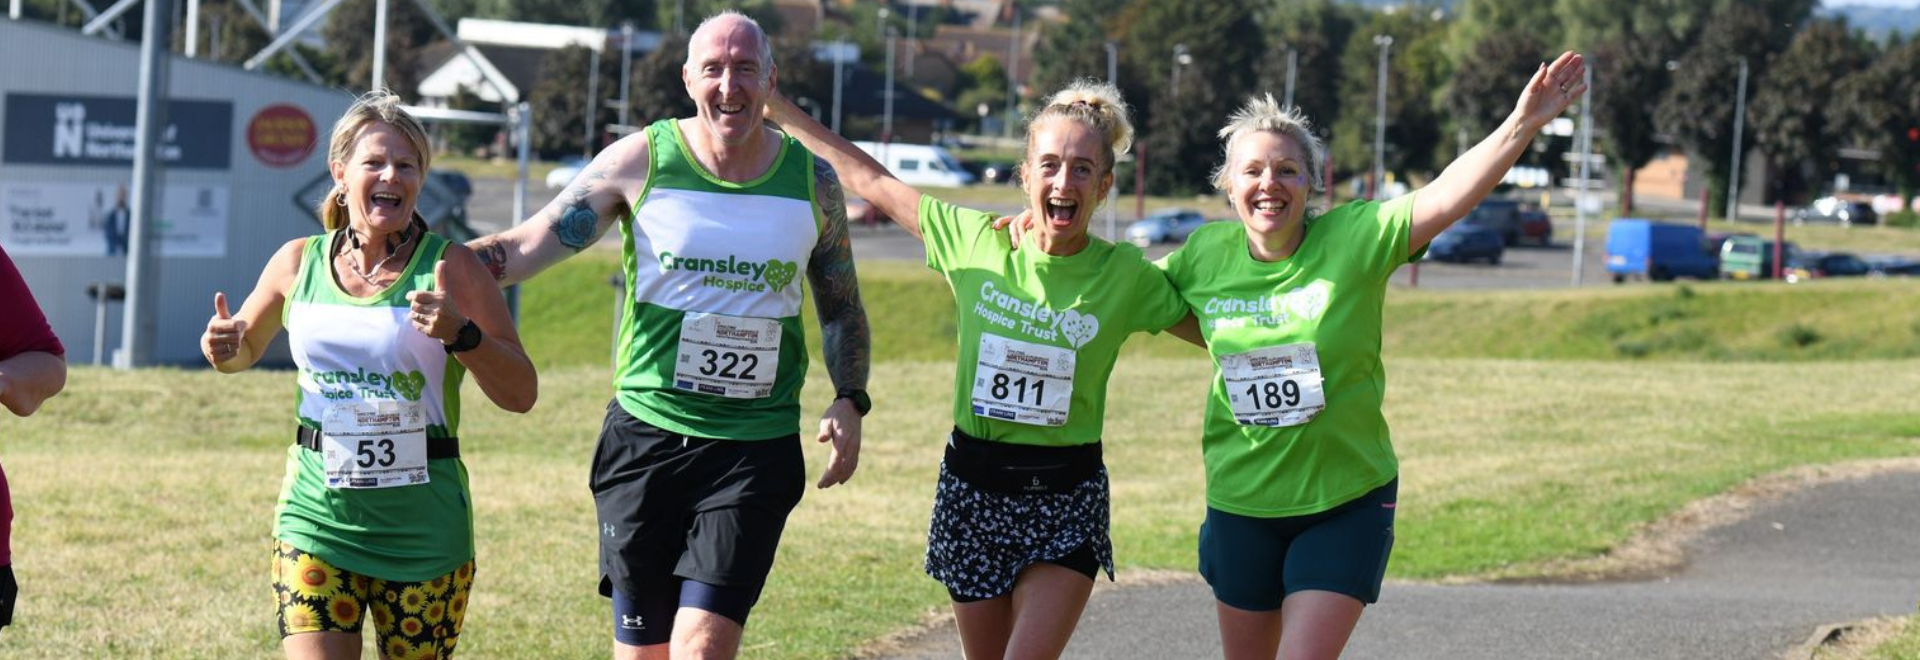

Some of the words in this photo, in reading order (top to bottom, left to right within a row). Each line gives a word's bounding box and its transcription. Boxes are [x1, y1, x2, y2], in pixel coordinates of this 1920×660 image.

[659, 251, 767, 281] Cransley
[703, 275, 765, 293] Hospice
[980, 280, 1066, 330] Cransley
[974, 302, 1016, 329] Hospice
[1020, 320, 1059, 342] Trust
[303, 366, 392, 391] ransley
[699, 349, 758, 380] 322
[358, 386, 397, 400] Trust
[991, 373, 1045, 406] 811
[1246, 380, 1300, 410] 189
[356, 438, 396, 468] 53
